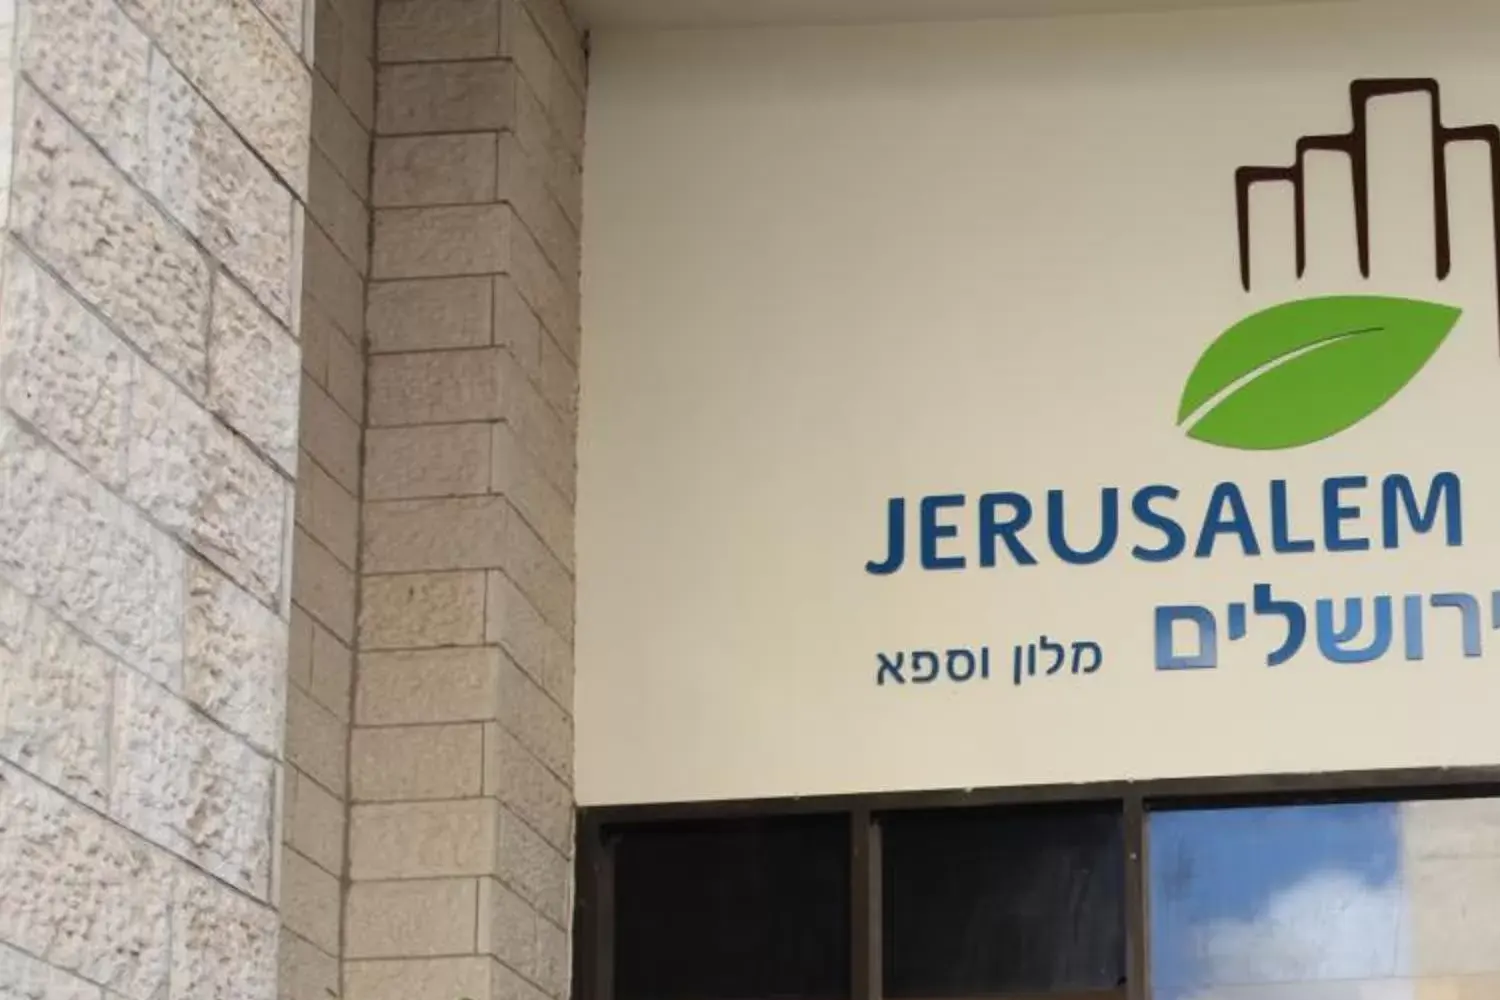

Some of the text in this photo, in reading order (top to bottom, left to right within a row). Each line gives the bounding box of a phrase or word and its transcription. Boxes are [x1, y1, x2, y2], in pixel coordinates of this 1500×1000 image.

[864, 471, 1463, 577] JERUSALEM
[876, 635, 1103, 686] מלון וספא
